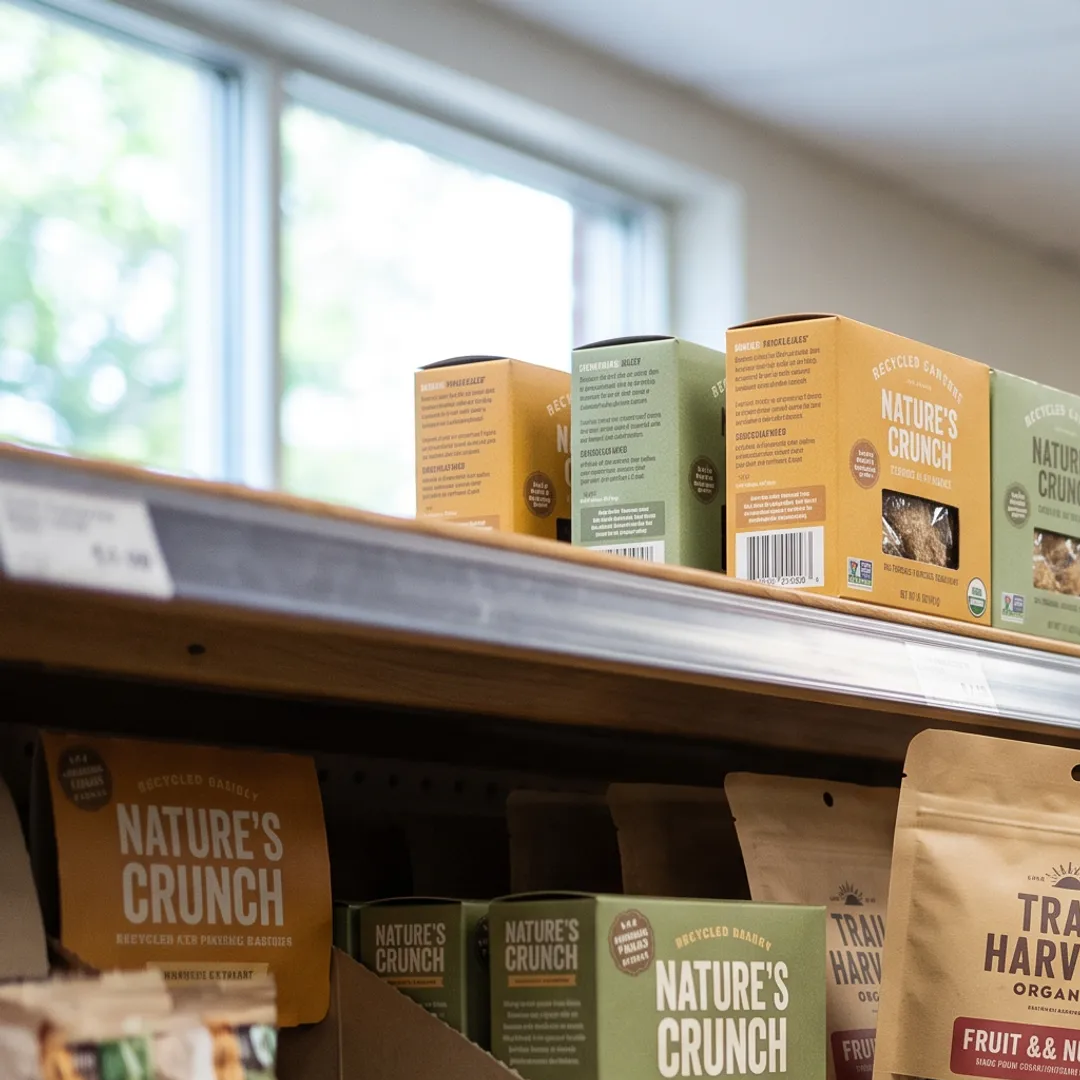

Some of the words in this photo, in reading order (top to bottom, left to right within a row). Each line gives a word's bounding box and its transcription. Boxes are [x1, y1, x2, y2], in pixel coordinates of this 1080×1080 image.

[881, 388, 958, 439] NATURE'S
[888, 426, 952, 472] CRUNCH
[116, 803, 283, 862] NATURE'S
[122, 862, 284, 927] CRUNCH
[375, 923, 446, 946] NATURE'S
[505, 918, 579, 943] NATURE'S
[831, 913, 884, 948] TRAI
[375, 947, 444, 973] CRUNCH
[505, 944, 577, 971] CRUNCH
[656, 960, 789, 1012] NATURE'S
[657, 1017, 787, 1078] CRUNCH
[963, 1028, 1022, 1056] FRUIT
[1026, 1035, 1057, 1060] &&
